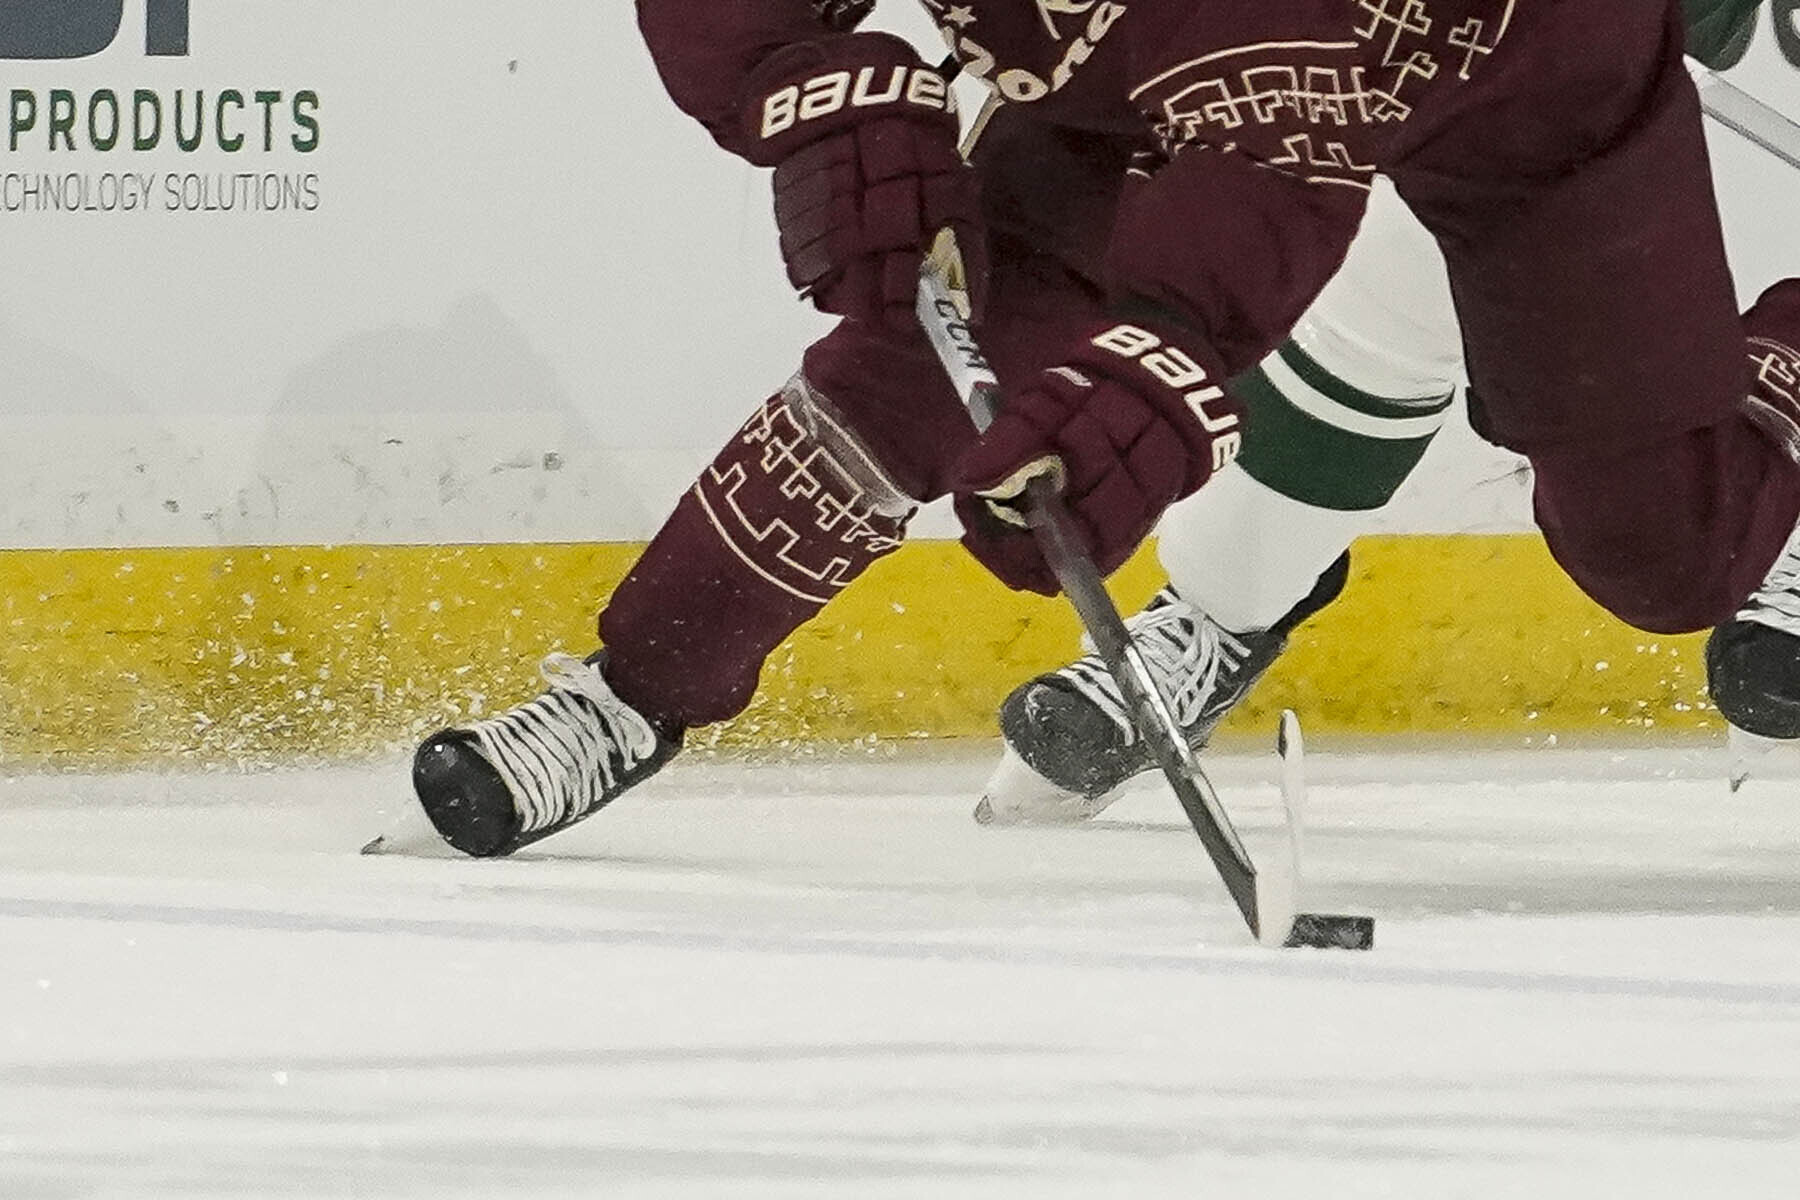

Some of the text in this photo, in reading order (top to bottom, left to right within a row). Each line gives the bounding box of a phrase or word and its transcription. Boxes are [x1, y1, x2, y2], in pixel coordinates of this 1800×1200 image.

[8, 87, 321, 152] PRODUCTS
[0, 171, 320, 212] CHNOLOGY SOLUTIONS
[1090, 324, 1242, 472] BAUE
